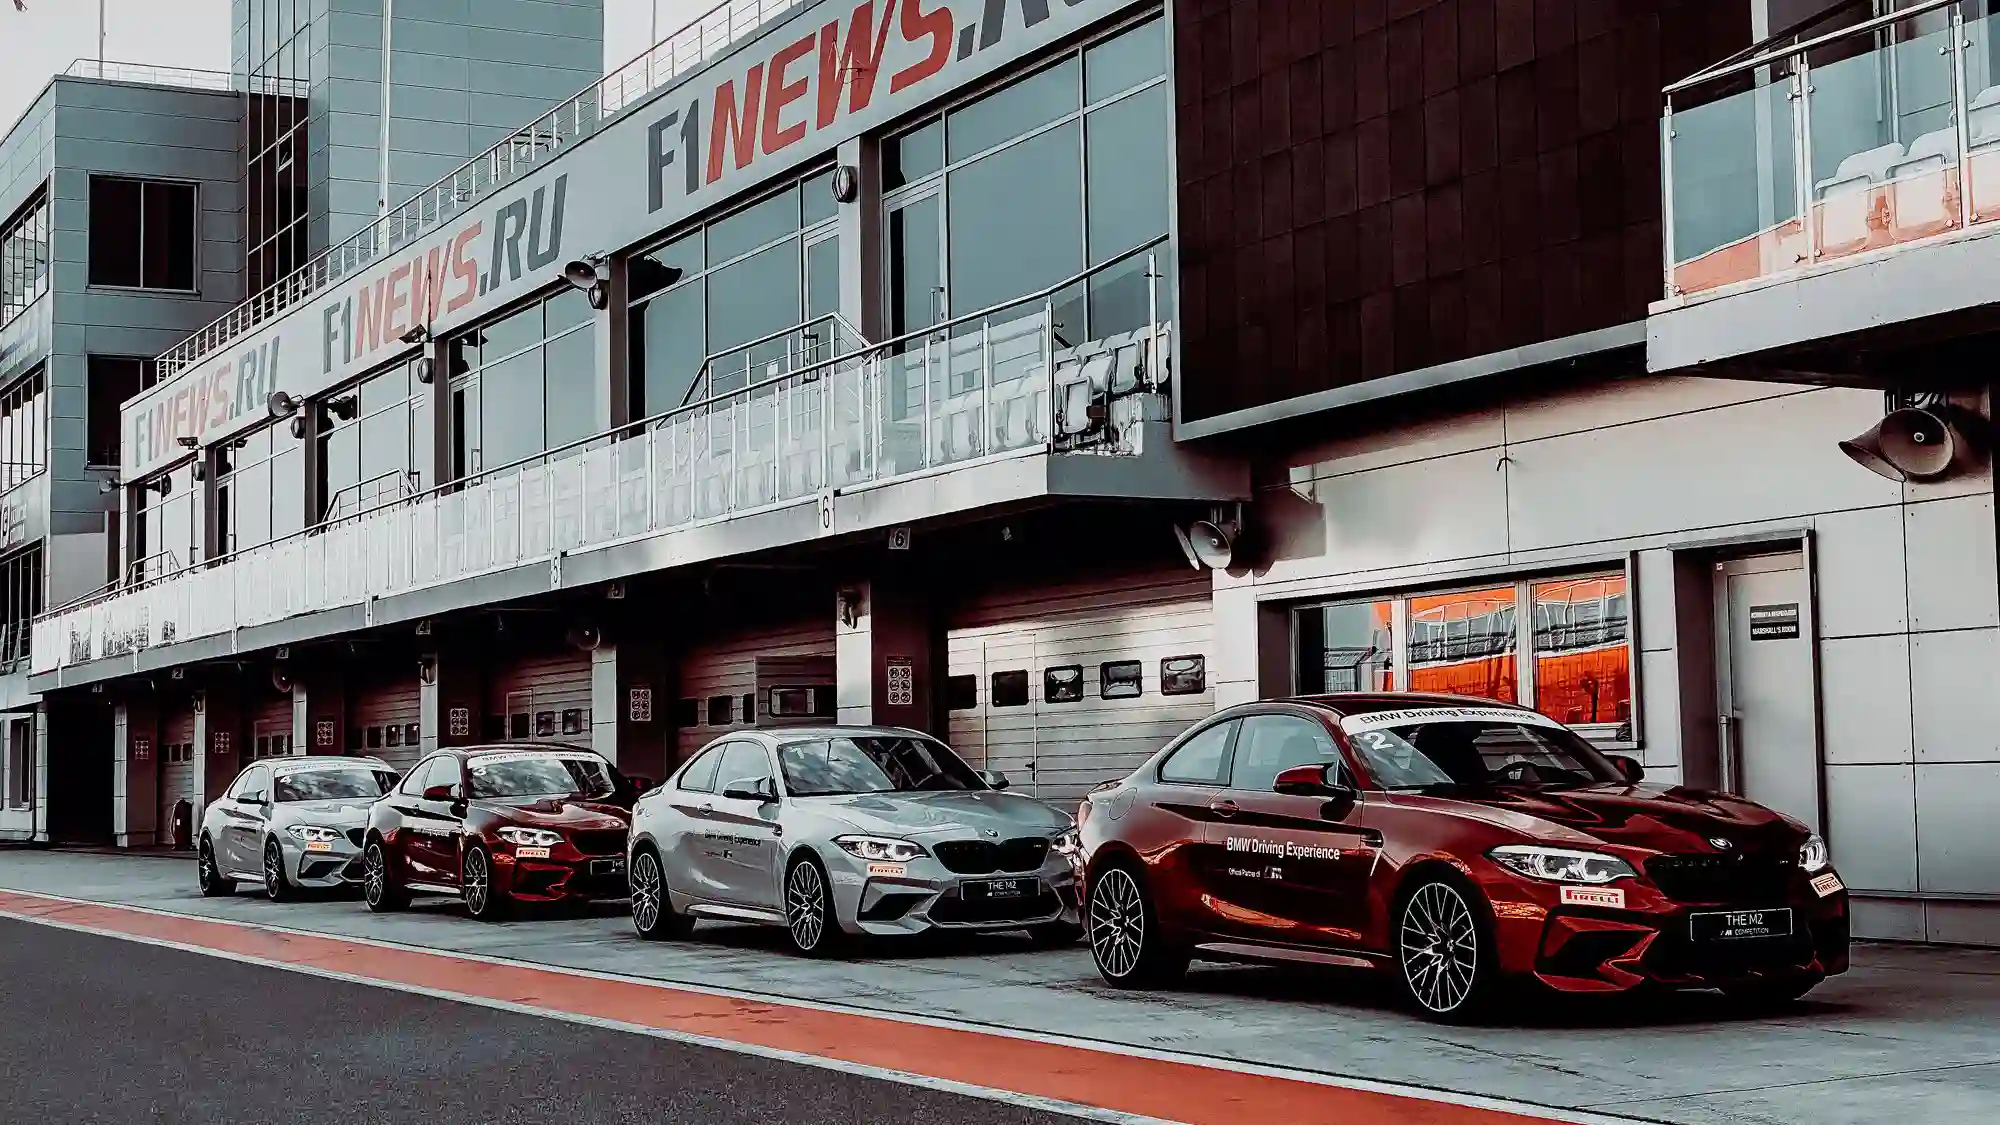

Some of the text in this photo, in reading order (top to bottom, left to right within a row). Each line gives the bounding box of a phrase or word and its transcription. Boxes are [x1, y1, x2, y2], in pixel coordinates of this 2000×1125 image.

[648, 0, 1085, 214] F1NEWS.
[323, 173, 568, 374] F1NEWS.RU
[135, 335, 280, 468] F1NEWS.RU
[822, 496, 830, 529] 6
[894, 528, 905, 548] 6
[553, 556, 558, 584] 5
[1360, 708, 1536, 724] BMW Driving Experience
[1363, 732, 1394, 750] 2
[1226, 836, 1340, 860] BMW Driving Experience
[987, 880, 1017, 891] THE M2
[1813, 876, 1839, 893] PIRELLI
[1565, 889, 1619, 904] PIRELLI
[1725, 913, 1764, 926] THE M2
